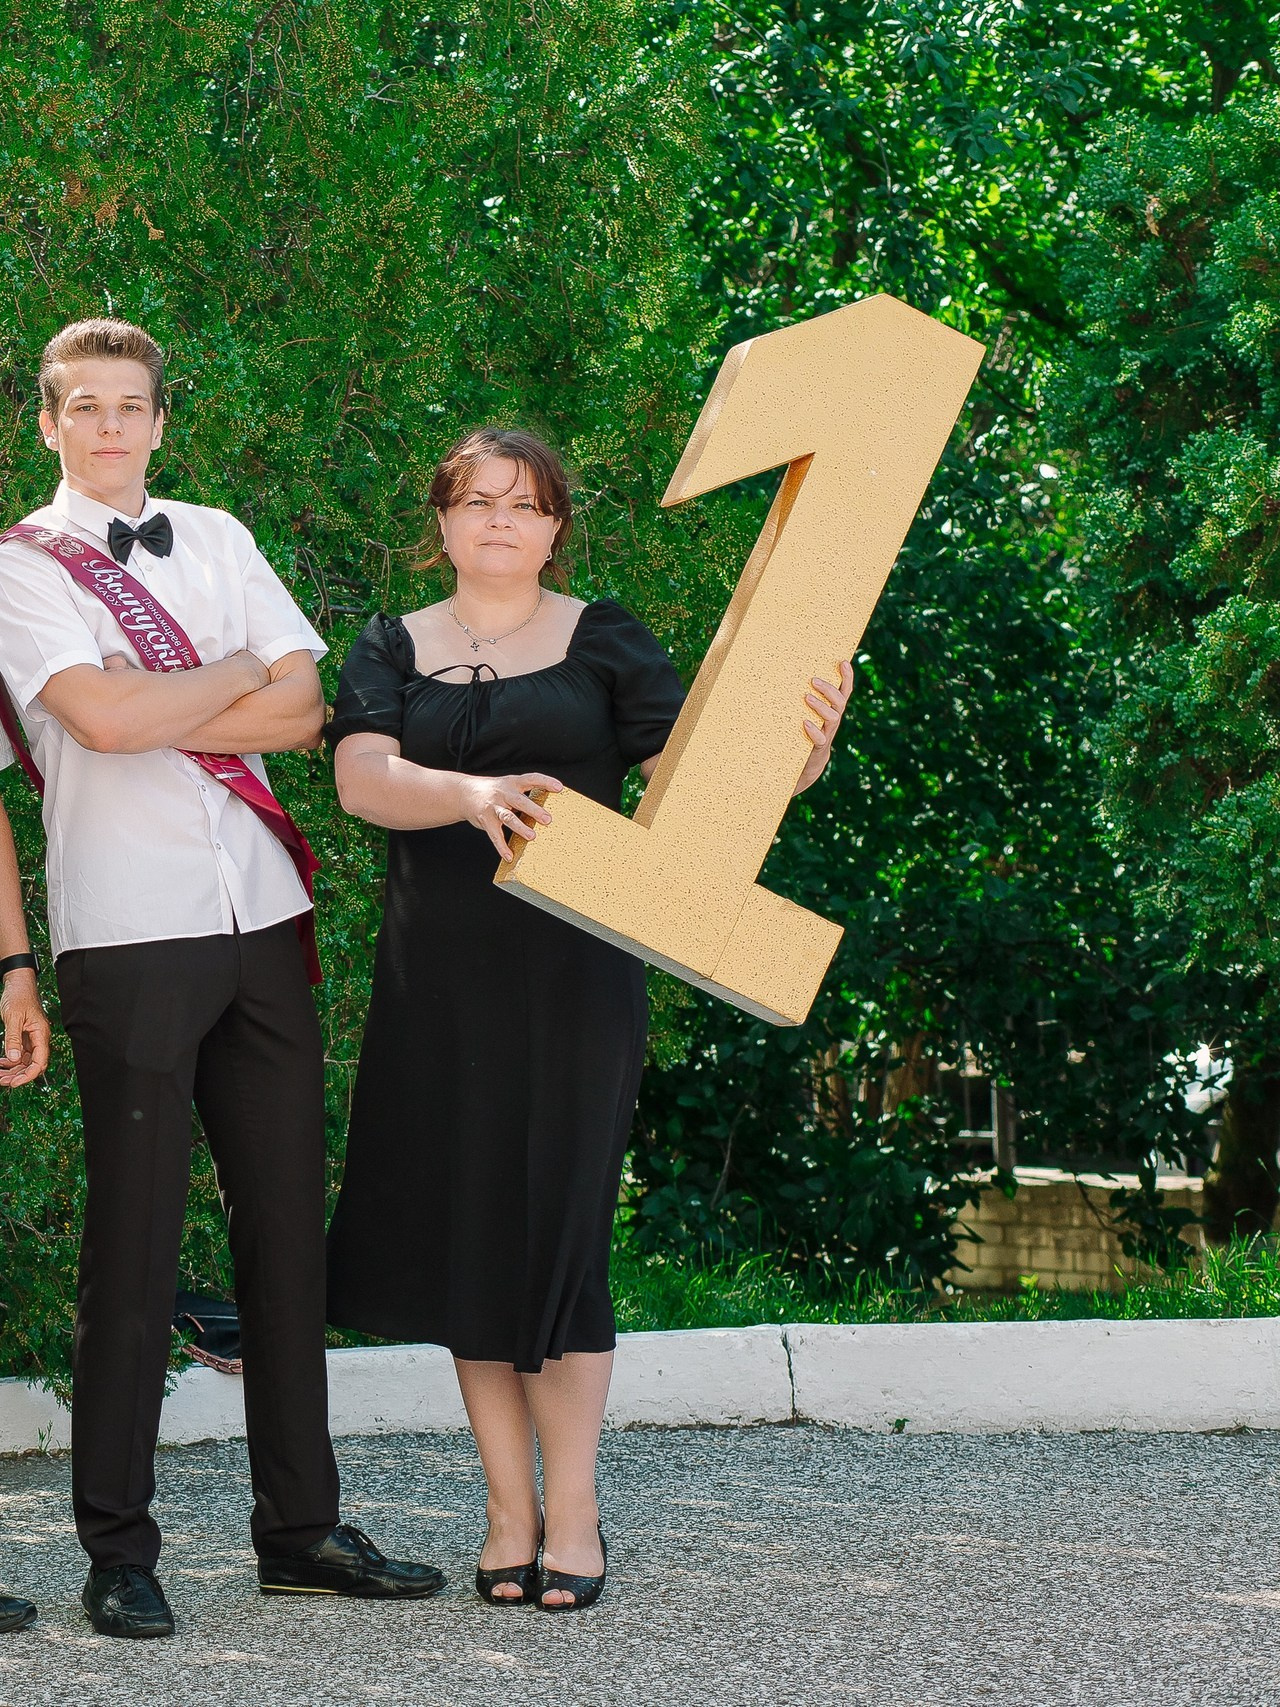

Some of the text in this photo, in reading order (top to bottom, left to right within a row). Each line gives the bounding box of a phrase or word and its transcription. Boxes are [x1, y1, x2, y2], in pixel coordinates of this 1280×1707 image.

[92, 582, 121, 608] МАОУ
[134, 634, 156, 661] СОШ
[141, 597, 182, 647] Пономарев
[494, 292, 987, 1028] 1
